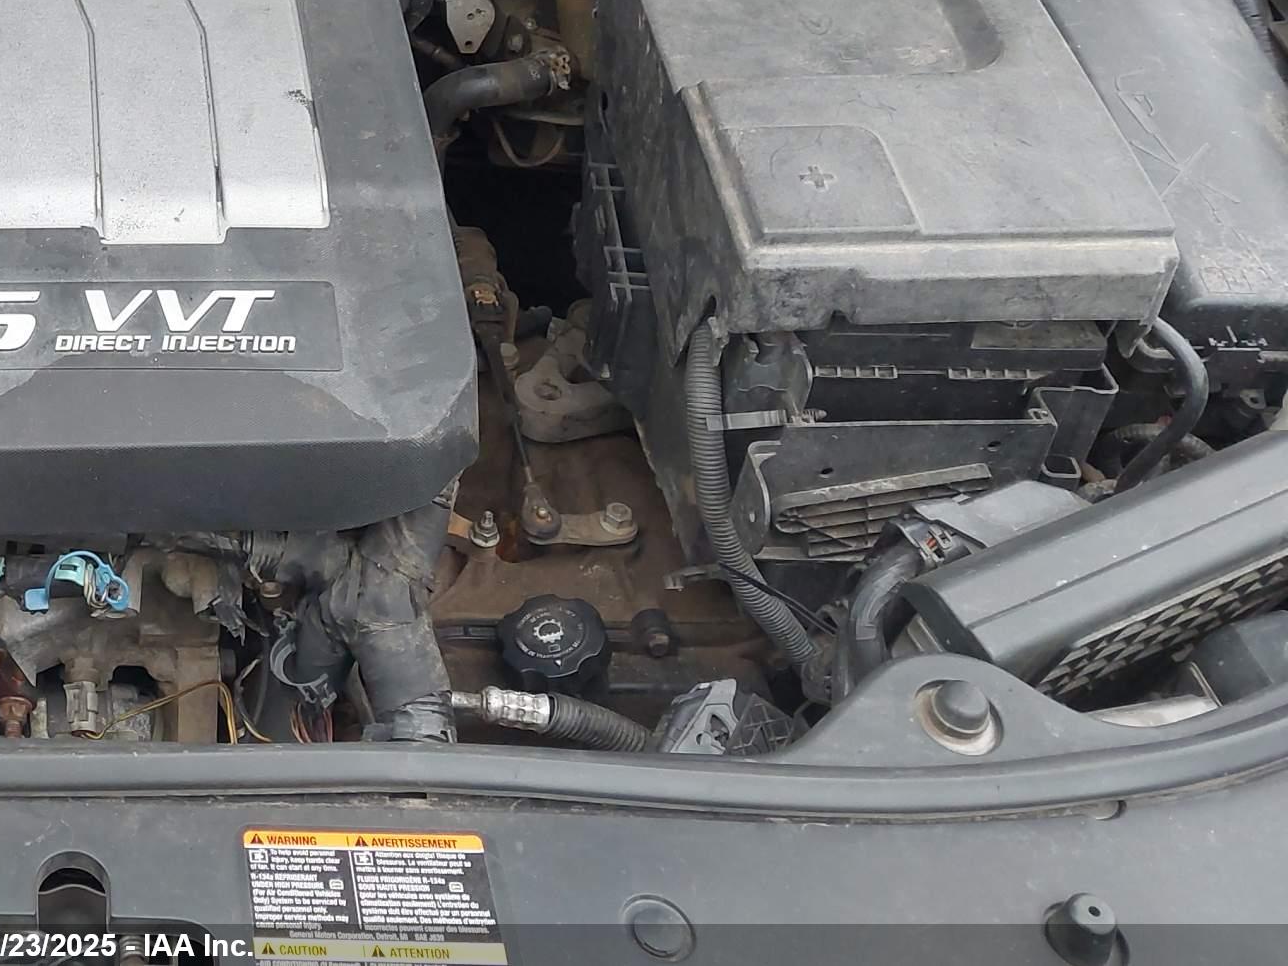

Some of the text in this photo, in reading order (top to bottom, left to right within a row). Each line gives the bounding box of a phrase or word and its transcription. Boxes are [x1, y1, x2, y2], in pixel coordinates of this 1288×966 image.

[86, 290, 276, 332] VVT
[55, 335, 150, 352] DIRECT
[267, 835, 317, 845] WARNING
[372, 838, 457, 848] AVERTISSEMENT
[277, 889, 314, 897] Conditioned
[399, 884, 430, 892] PRESSION
[253, 897, 270, 905] Only)
[271, 897, 294, 905] System
[254, 905, 281, 913] qualified
[255, 913, 283, 921] Improper
[280, 945, 327, 956] CAUTION
[390, 948, 450, 958] ATTENTION
